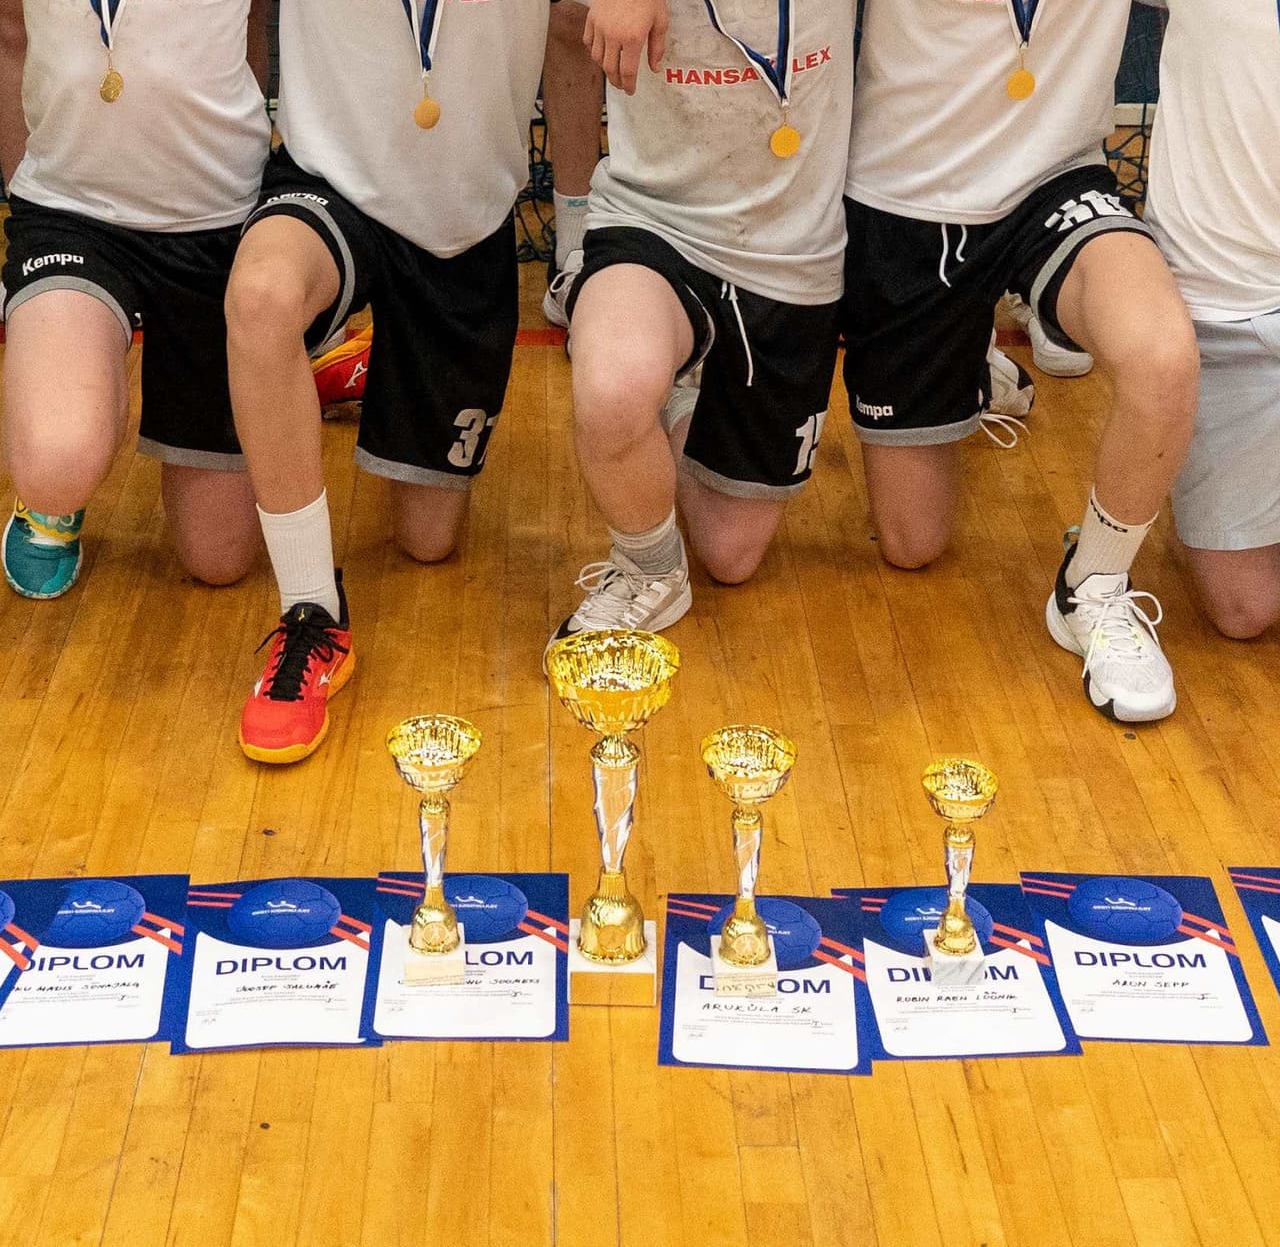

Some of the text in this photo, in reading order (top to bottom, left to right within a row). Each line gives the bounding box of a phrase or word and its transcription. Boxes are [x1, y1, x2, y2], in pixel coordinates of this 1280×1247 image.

[665, 45, 832, 86] HANSA LEX
[22, 252, 84, 277] Kempa
[447, 408, 498, 467] 3
[23, 953, 145, 972] DIPLOM
[215, 955, 347, 976] DIPLOM
[464, 950, 534, 966] LOM
[1074, 951, 1207, 969] DIPLOM
[699, 974, 831, 994] DOM
[887, 965, 1020, 983] DIM
